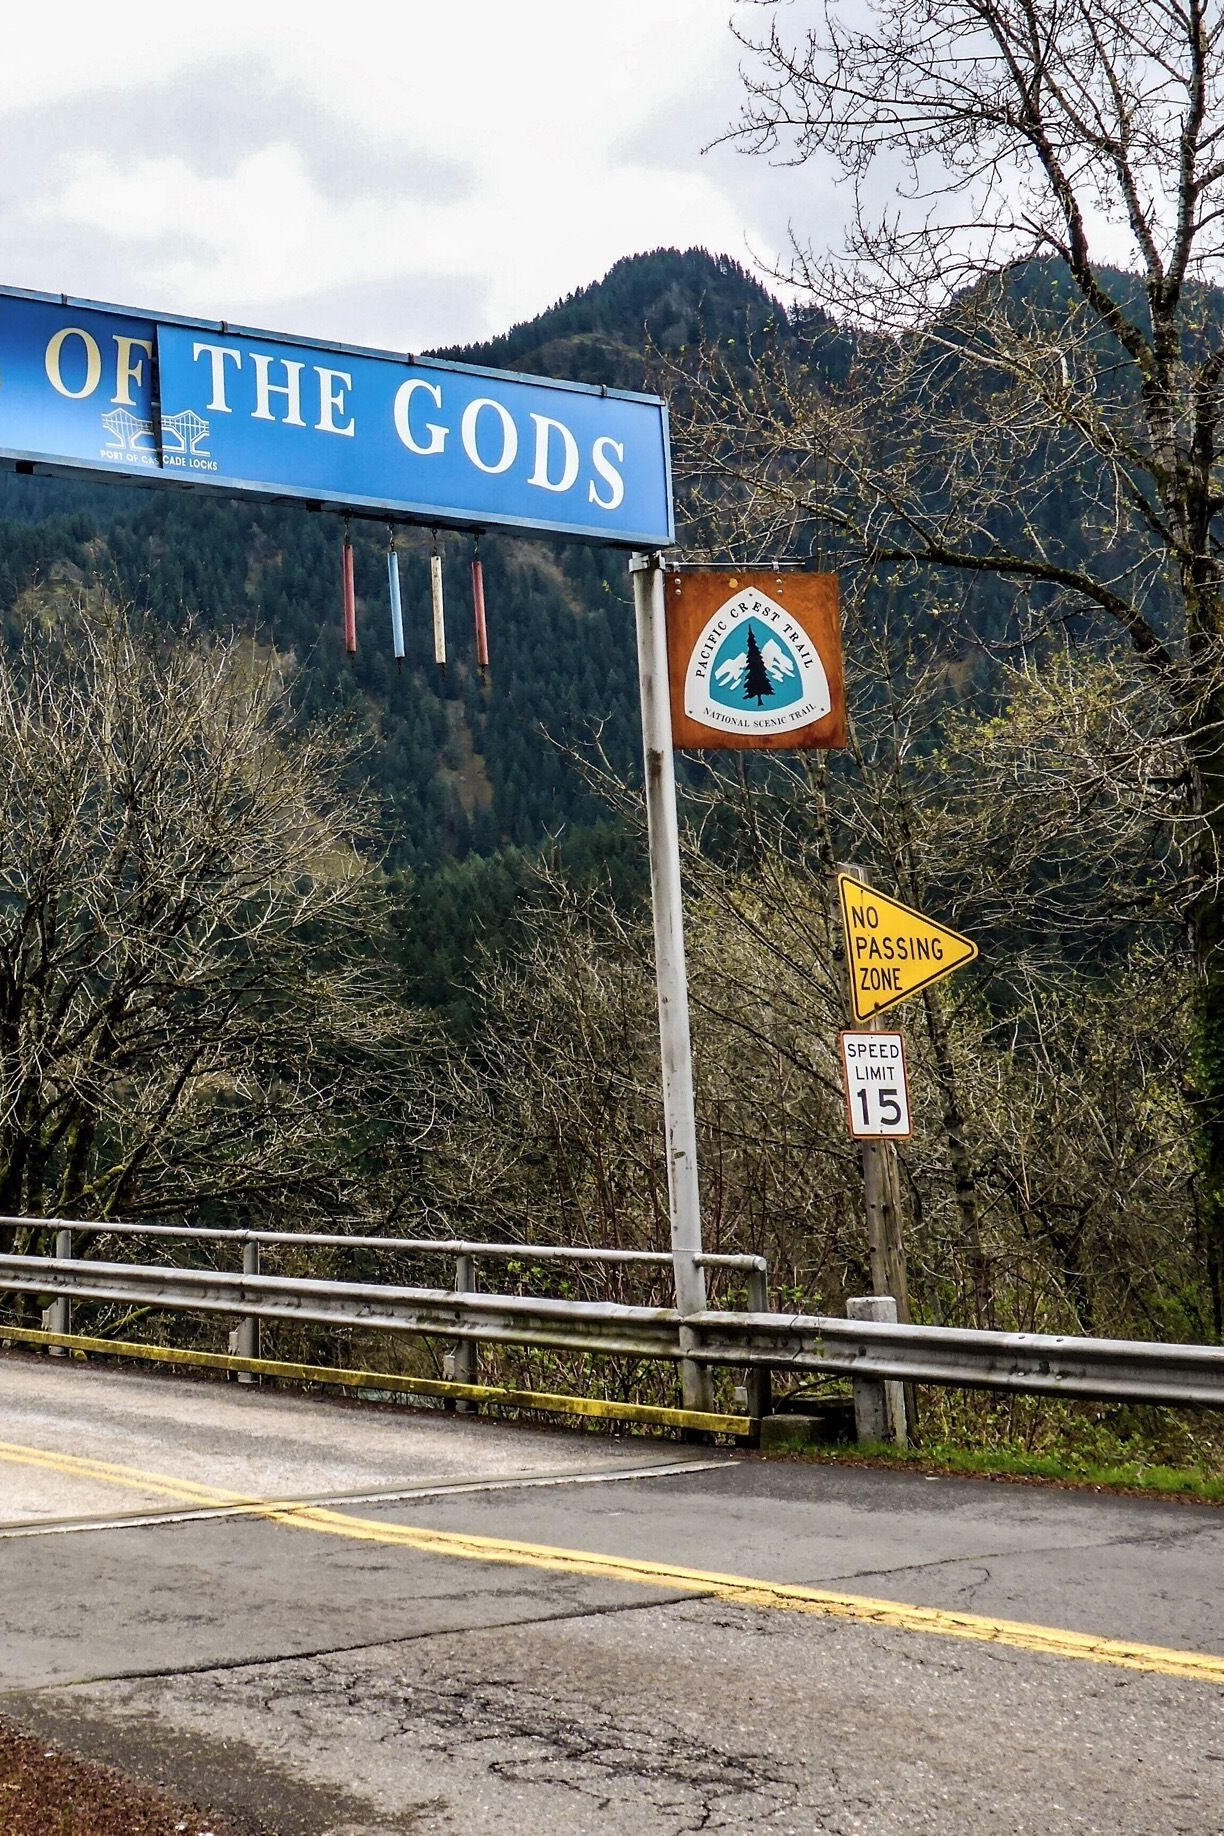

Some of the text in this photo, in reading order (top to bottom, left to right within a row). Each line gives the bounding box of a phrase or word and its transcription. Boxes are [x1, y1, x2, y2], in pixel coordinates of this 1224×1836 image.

[45, 327, 152, 406] OF
[193, 342, 355, 437] THE
[393, 378, 625, 510] GODS
[100, 450, 123, 461] PORT
[126, 453, 138, 462] OF
[189, 459, 218, 471] LOCKS
[695, 601, 814, 678] PACIFIC CREST TRAIL
[703, 703, 816, 728] NATIONAL SCENIC TRAIL
[851, 905, 879, 929] NO
[856, 936, 944, 961] PASSING
[859, 967, 903, 991] ZONE
[847, 1043, 899, 1059] SPEED
[855, 1066, 895, 1081] LIMIT
[857, 1088, 902, 1126] 15
